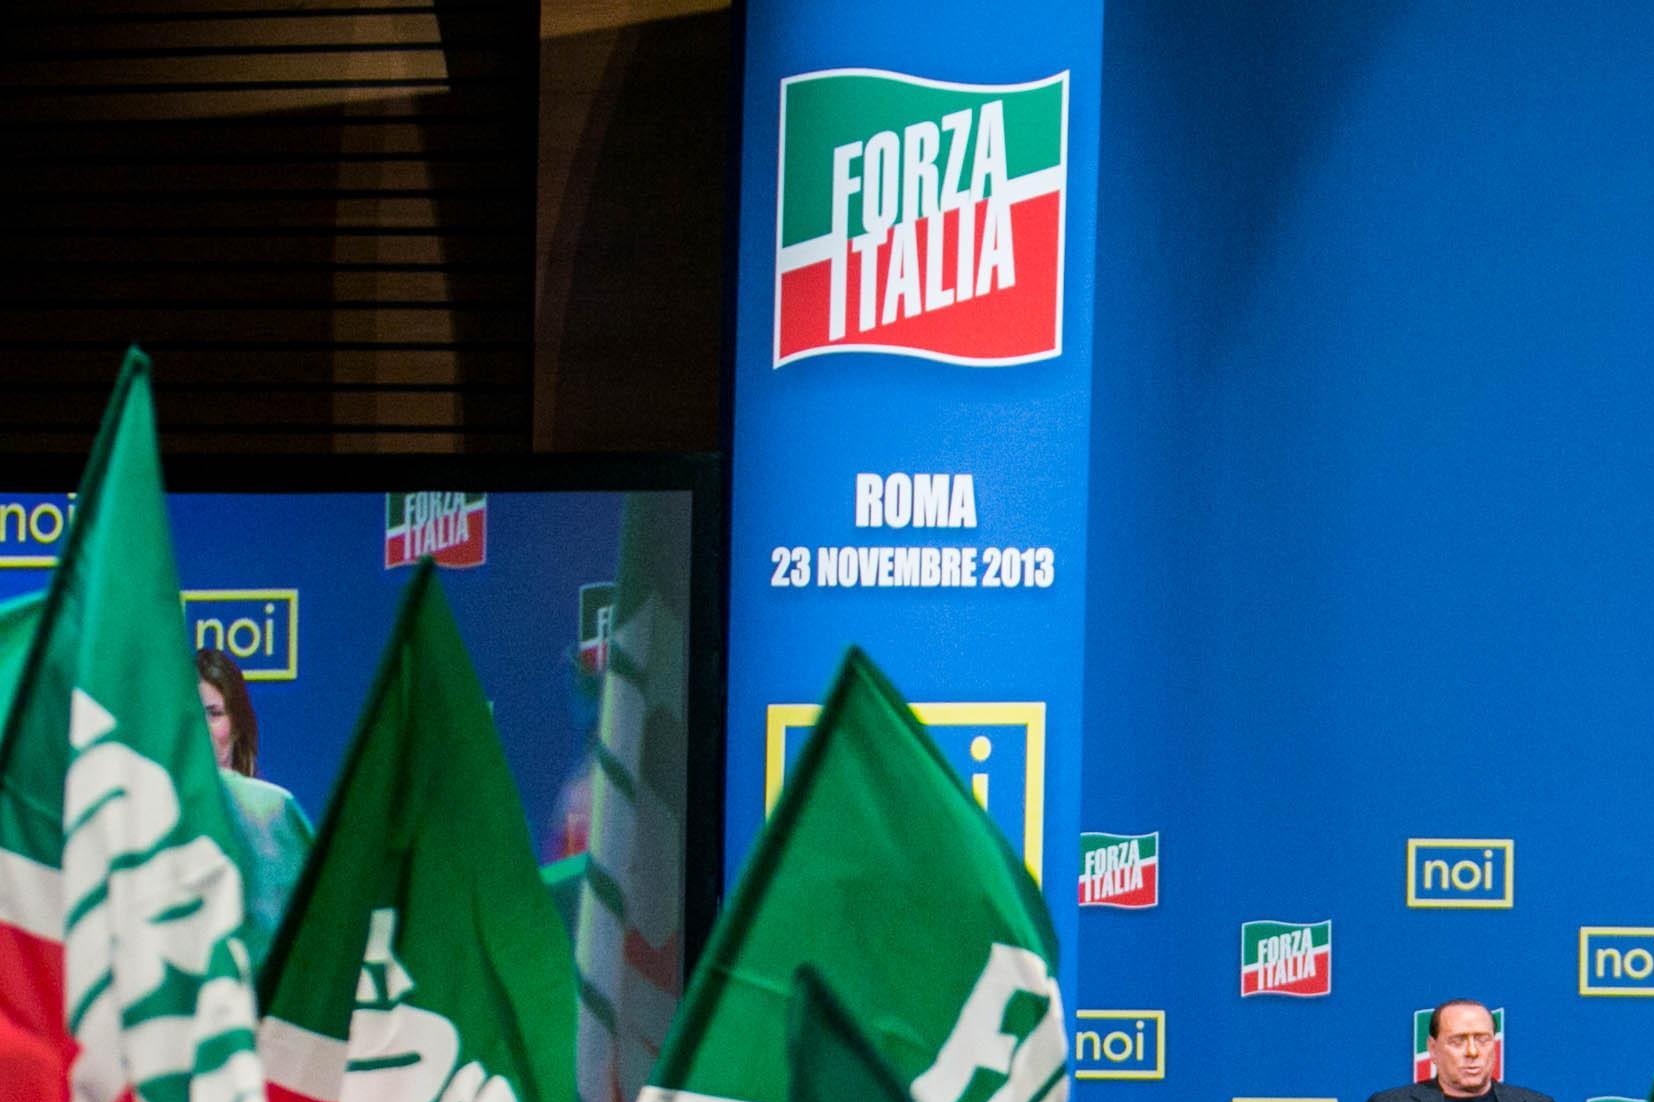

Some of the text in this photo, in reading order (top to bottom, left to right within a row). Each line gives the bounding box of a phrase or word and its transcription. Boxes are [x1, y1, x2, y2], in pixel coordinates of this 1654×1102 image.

[832, 99, 1007, 235] FORZA
[829, 196, 1015, 342] ITALIA
[855, 473, 977, 529] ROMA
[403, 511, 468, 560] ITALIA
[771, 547, 1055, 588] 23 NOVEMBRE 2013
[195, 603, 275, 656] noi
[1086, 839, 1140, 875] FORZA
[1423, 849, 1494, 891] noi
[1084, 867, 1143, 902] ITALIA
[1258, 928, 1312, 964] FORZA
[1257, 955, 1317, 990] ITALIA
[1076, 1020, 1145, 1061] noi
